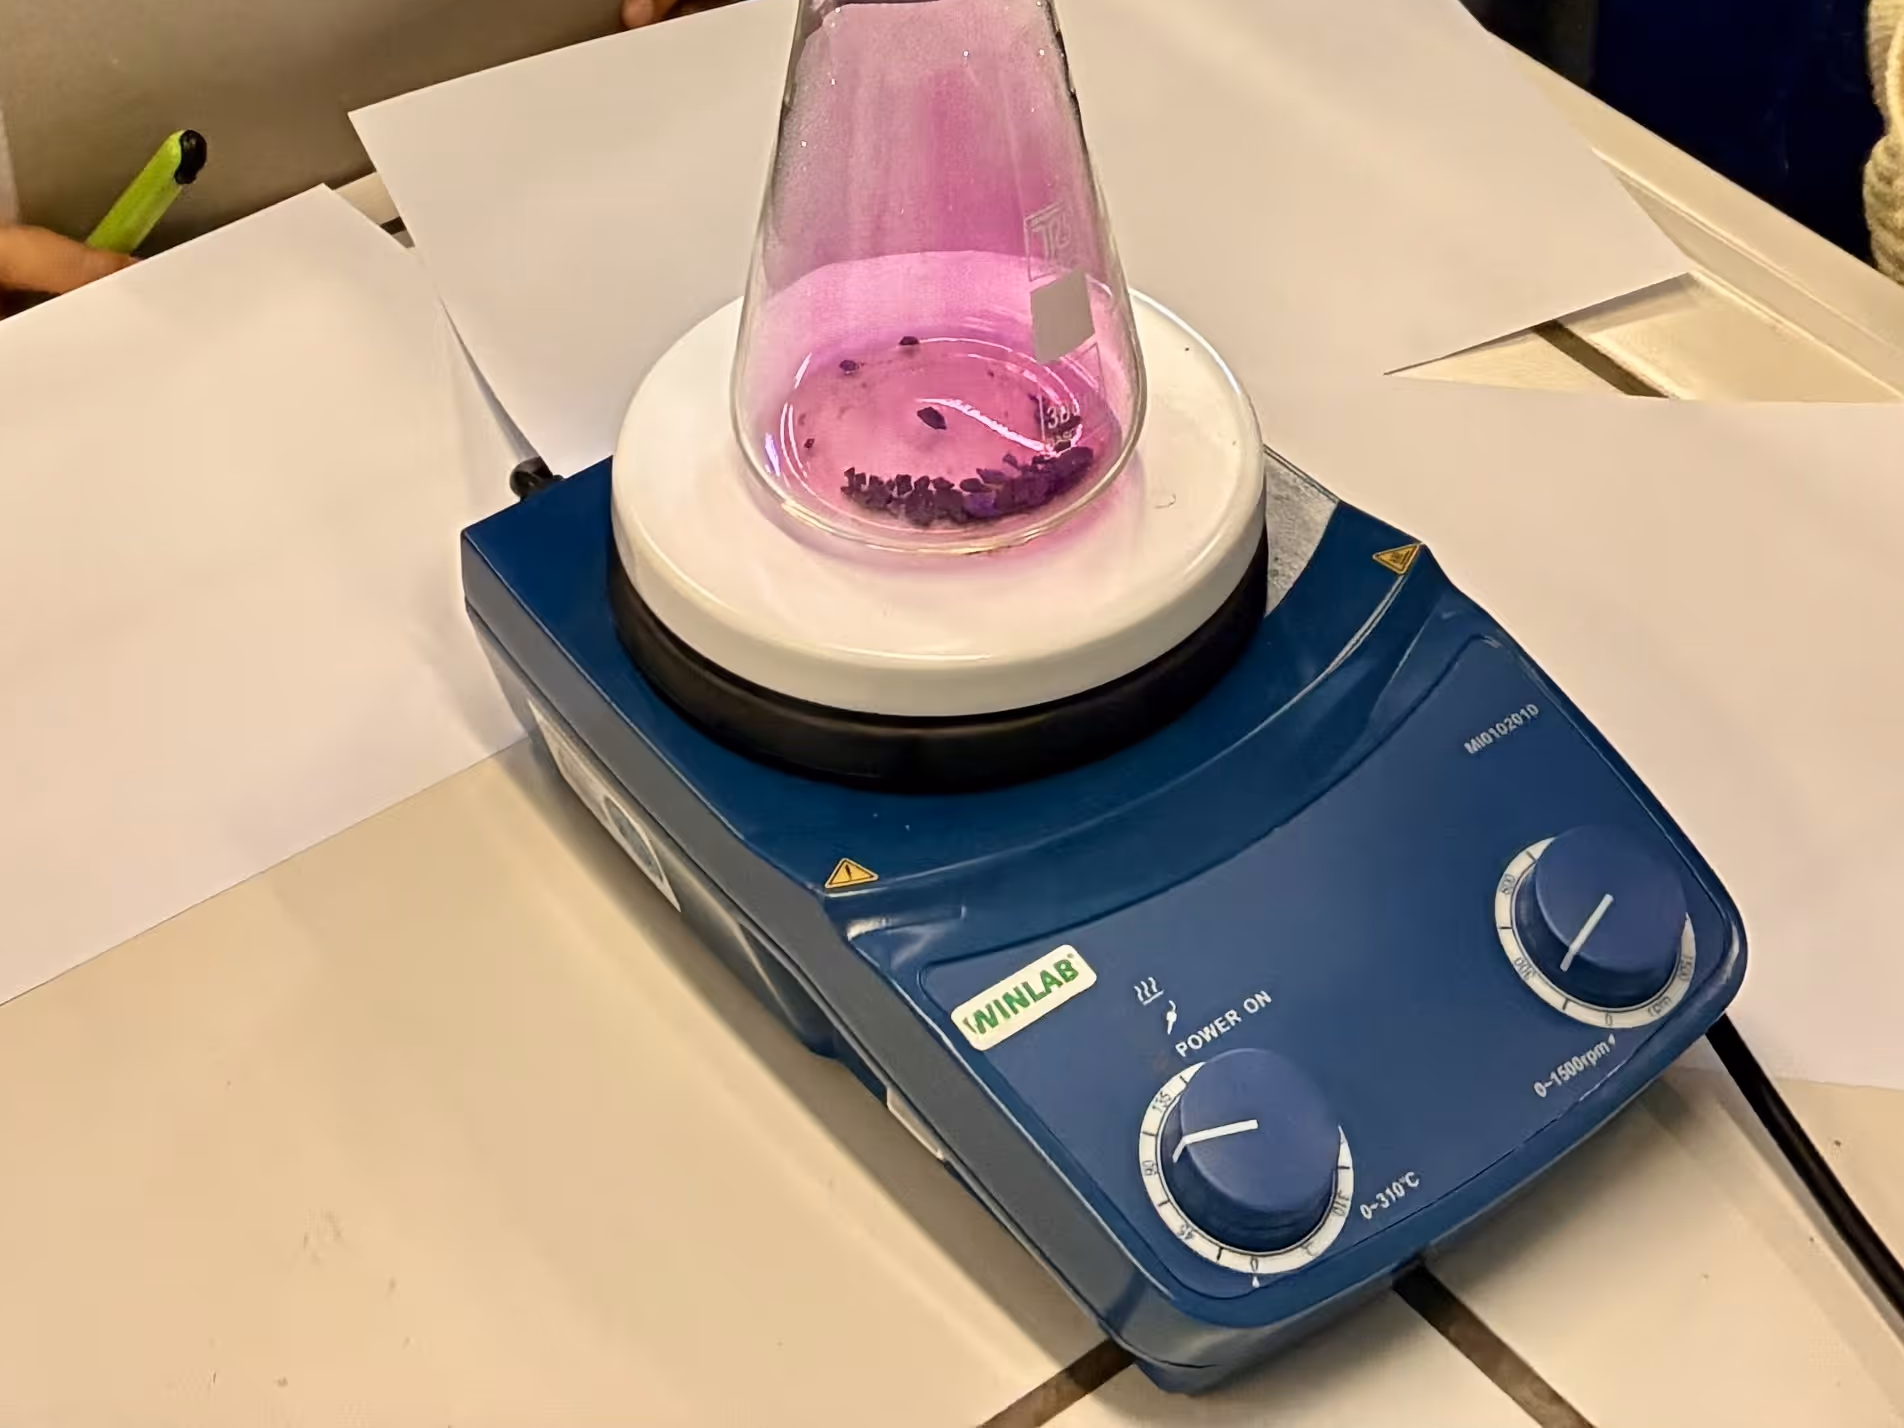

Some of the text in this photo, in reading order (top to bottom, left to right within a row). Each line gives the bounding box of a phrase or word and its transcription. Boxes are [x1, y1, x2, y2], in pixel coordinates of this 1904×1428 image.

[962, 958, 1080, 1034] WINLAB
[1175, 990, 1273, 1058] POWER ON
